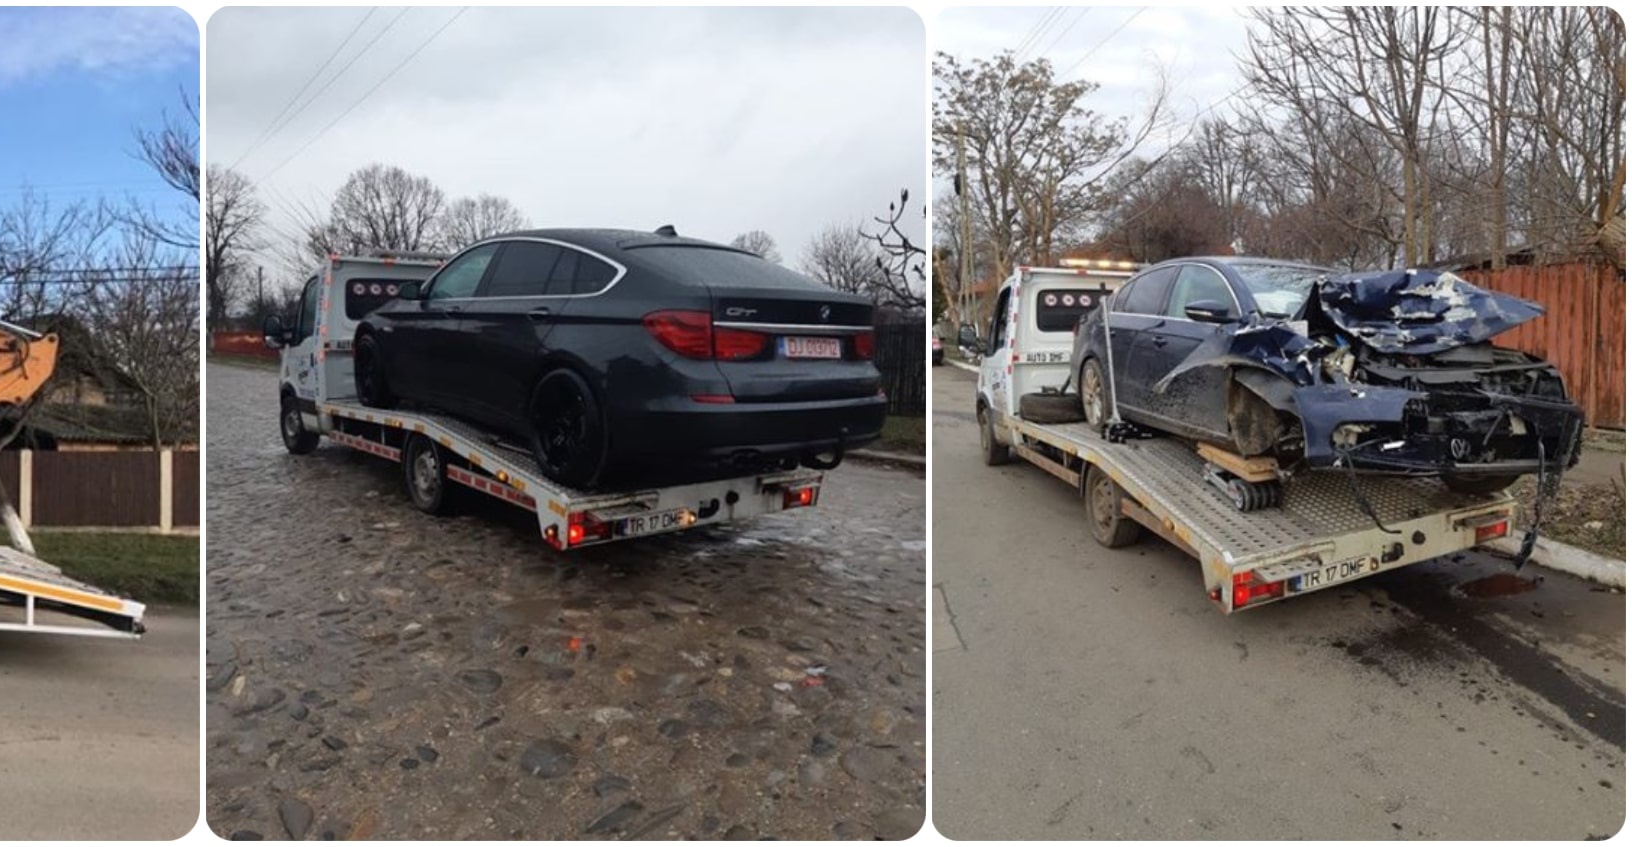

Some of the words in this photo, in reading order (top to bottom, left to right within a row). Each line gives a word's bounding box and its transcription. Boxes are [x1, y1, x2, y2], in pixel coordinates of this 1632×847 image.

[726, 307, 757, 316] GT
[1026, 352, 1047, 362] AUTO
[630, 517, 645, 534] TR
[1304, 570, 1321, 587] TR
[1326, 565, 1337, 581] 17
[1340, 557, 1366, 578] DMF
